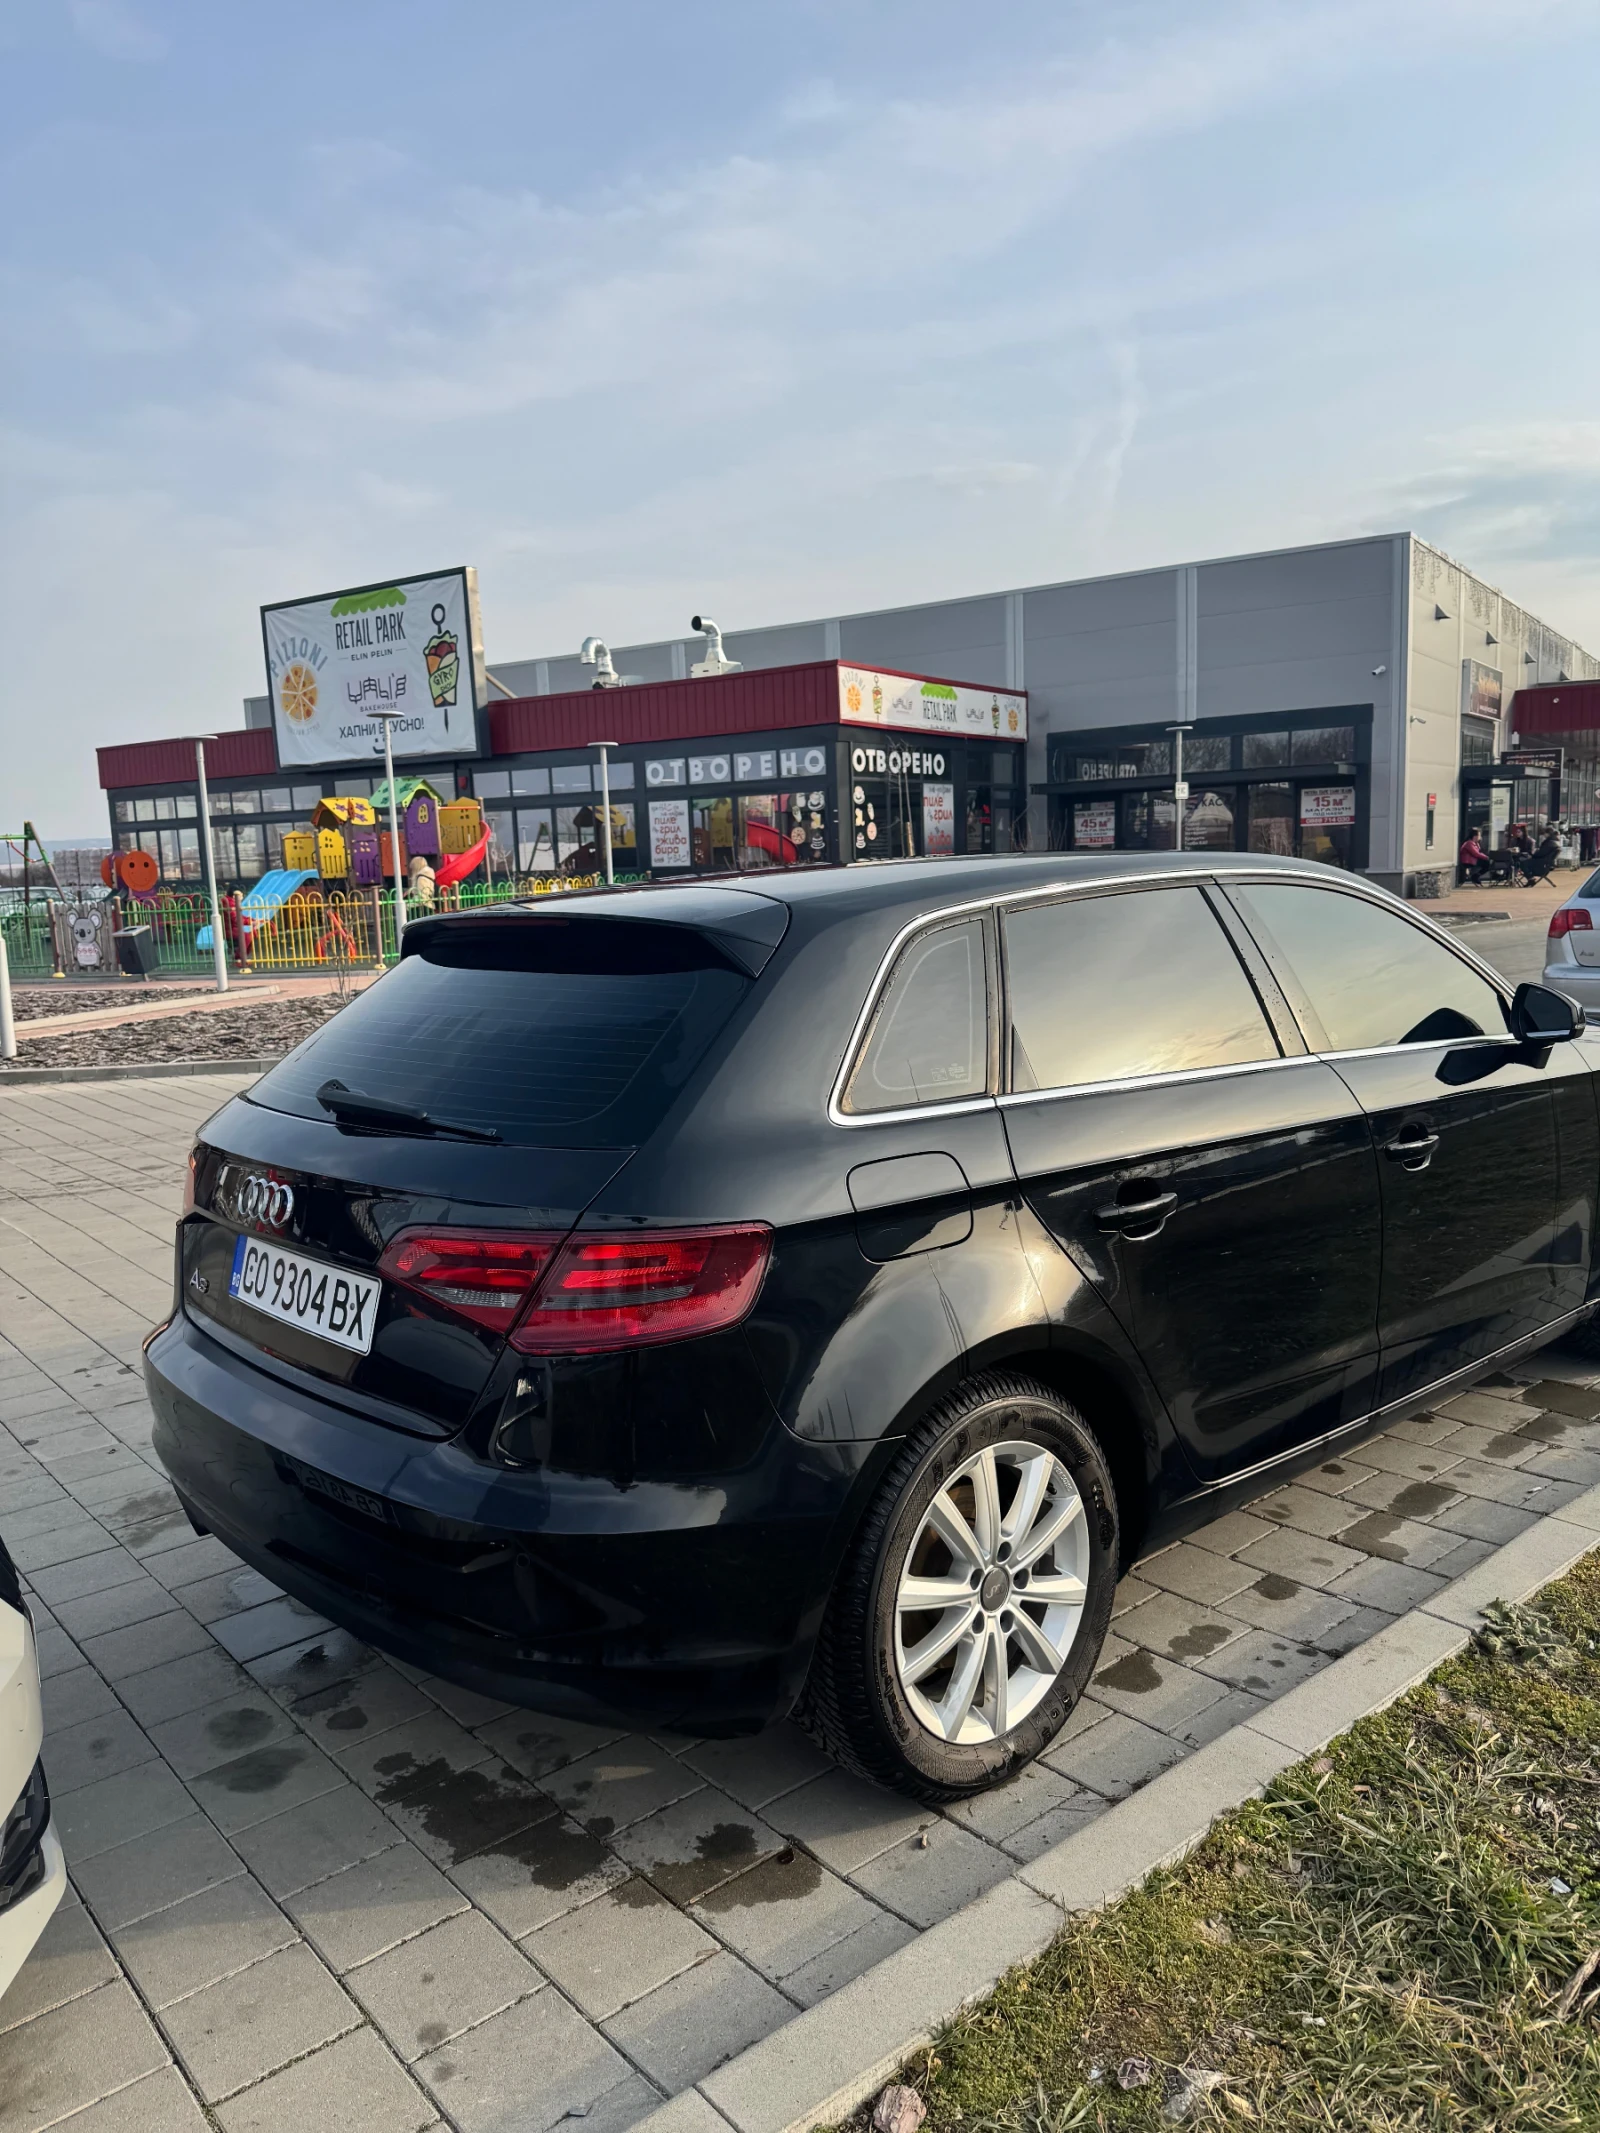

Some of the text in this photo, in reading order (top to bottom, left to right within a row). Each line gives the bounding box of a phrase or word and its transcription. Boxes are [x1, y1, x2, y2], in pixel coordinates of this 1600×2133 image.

[335, 611, 406, 650] RETAIL PARK
[270, 636, 328, 678] PIZZONI
[351, 648, 393, 661] ELIN PELIN
[360, 701, 398, 712] BAKEHOUSE
[922, 700, 942, 721] RETAIL
[942, 703, 958, 723] PARK
[339, 723, 376, 739] ХАПНИ
[646, 749, 825, 784] ОТВОРЕНО
[852, 748, 945, 776] ОТВОРЕНО
[1313, 796, 1331, 807] 15
[1081, 818, 1097, 828] 45
[231, 1271, 241, 1288] BG
